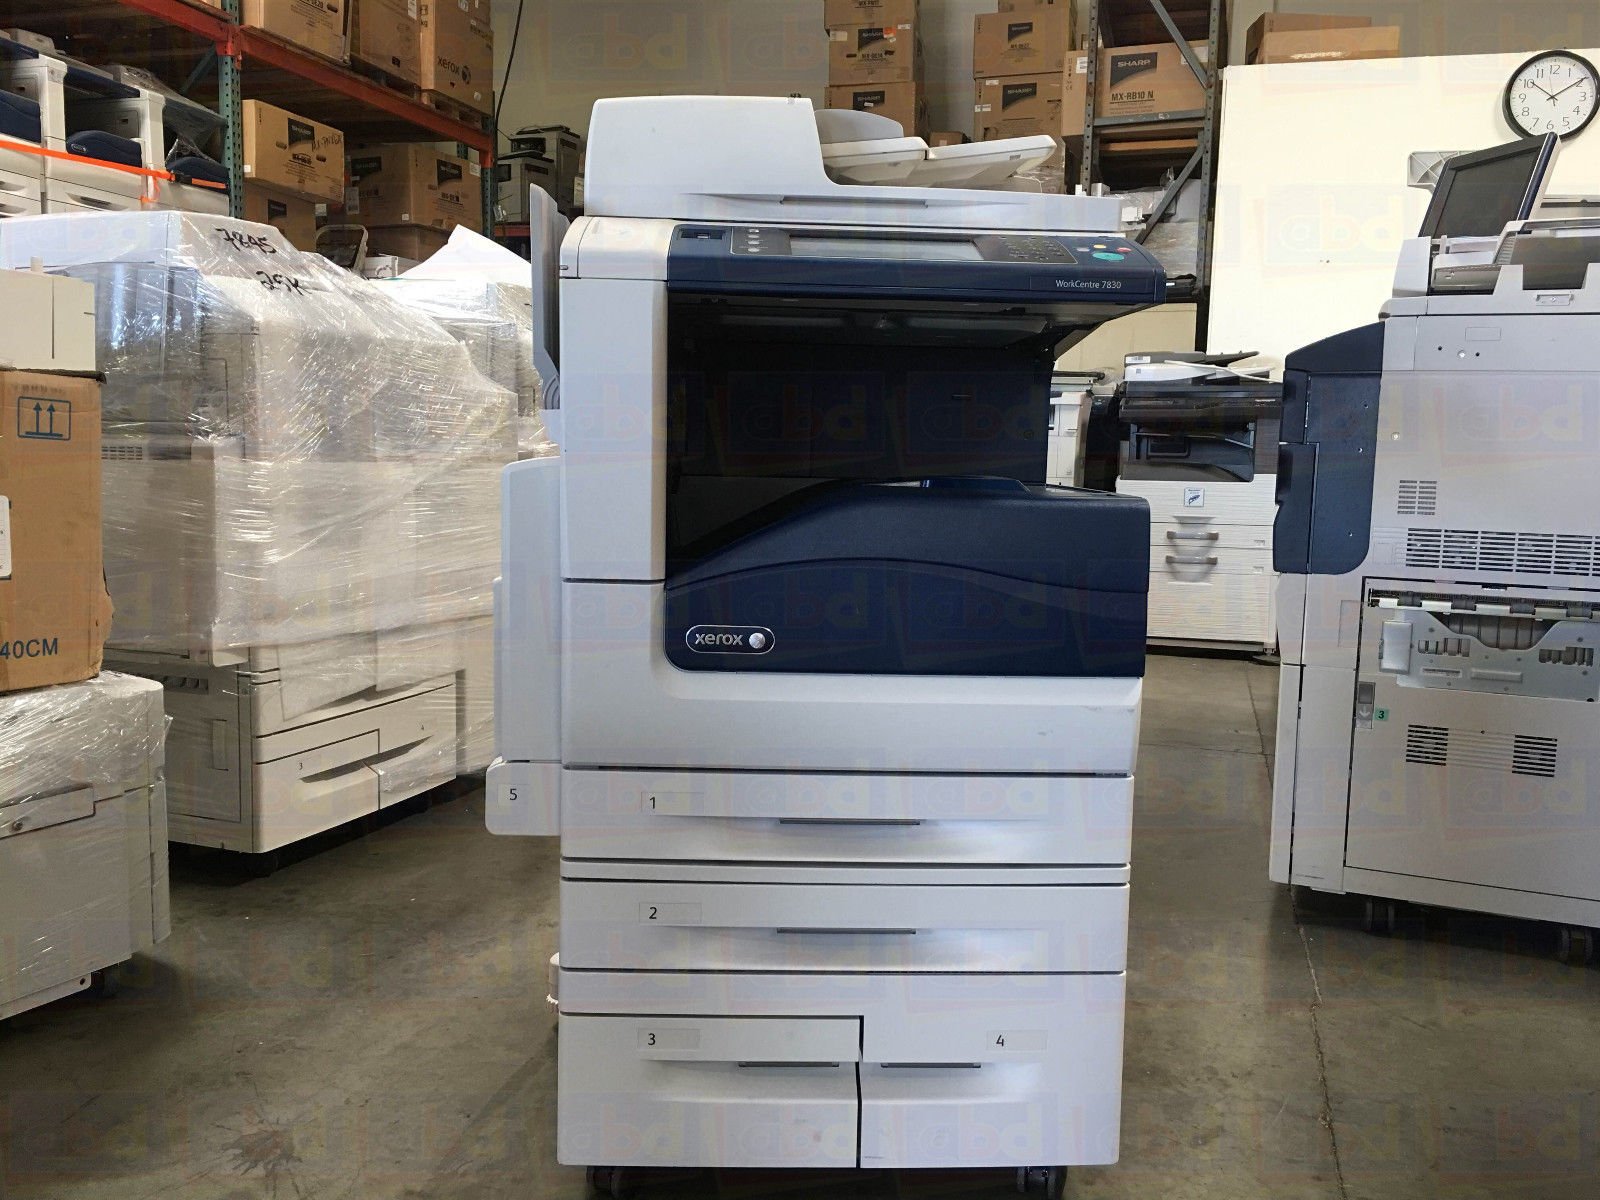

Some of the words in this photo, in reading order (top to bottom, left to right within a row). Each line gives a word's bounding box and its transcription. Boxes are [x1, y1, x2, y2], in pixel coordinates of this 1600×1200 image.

[437, 55, 460, 75] xerox
[1117, 59, 1151, 68] SHARP
[1549, 64, 1561, 75] 12
[1147, 90, 1154, 99] N
[1519, 93, 1527, 103] 9
[1580, 91, 1587, 102] 3
[1521, 106, 1530, 117] 8
[1572, 105, 1581, 115] 4
[1532, 117, 1540, 127] 7
[1546, 119, 1555, 130] 6
[1562, 116, 1570, 127] 5
[1055, 279, 1100, 288] WorkCentre
[1101, 280, 1122, 289] 7830
[694, 633, 744, 646] xerox
[0, 637, 58, 659] 40CM
[1378, 710, 1385, 719] 3
[509, 788, 518, 801] 5
[649, 796, 656, 809] 1
[648, 906, 658, 920] 2
[647, 1033, 656, 1046] 3
[995, 1034, 1005, 1047] 4
